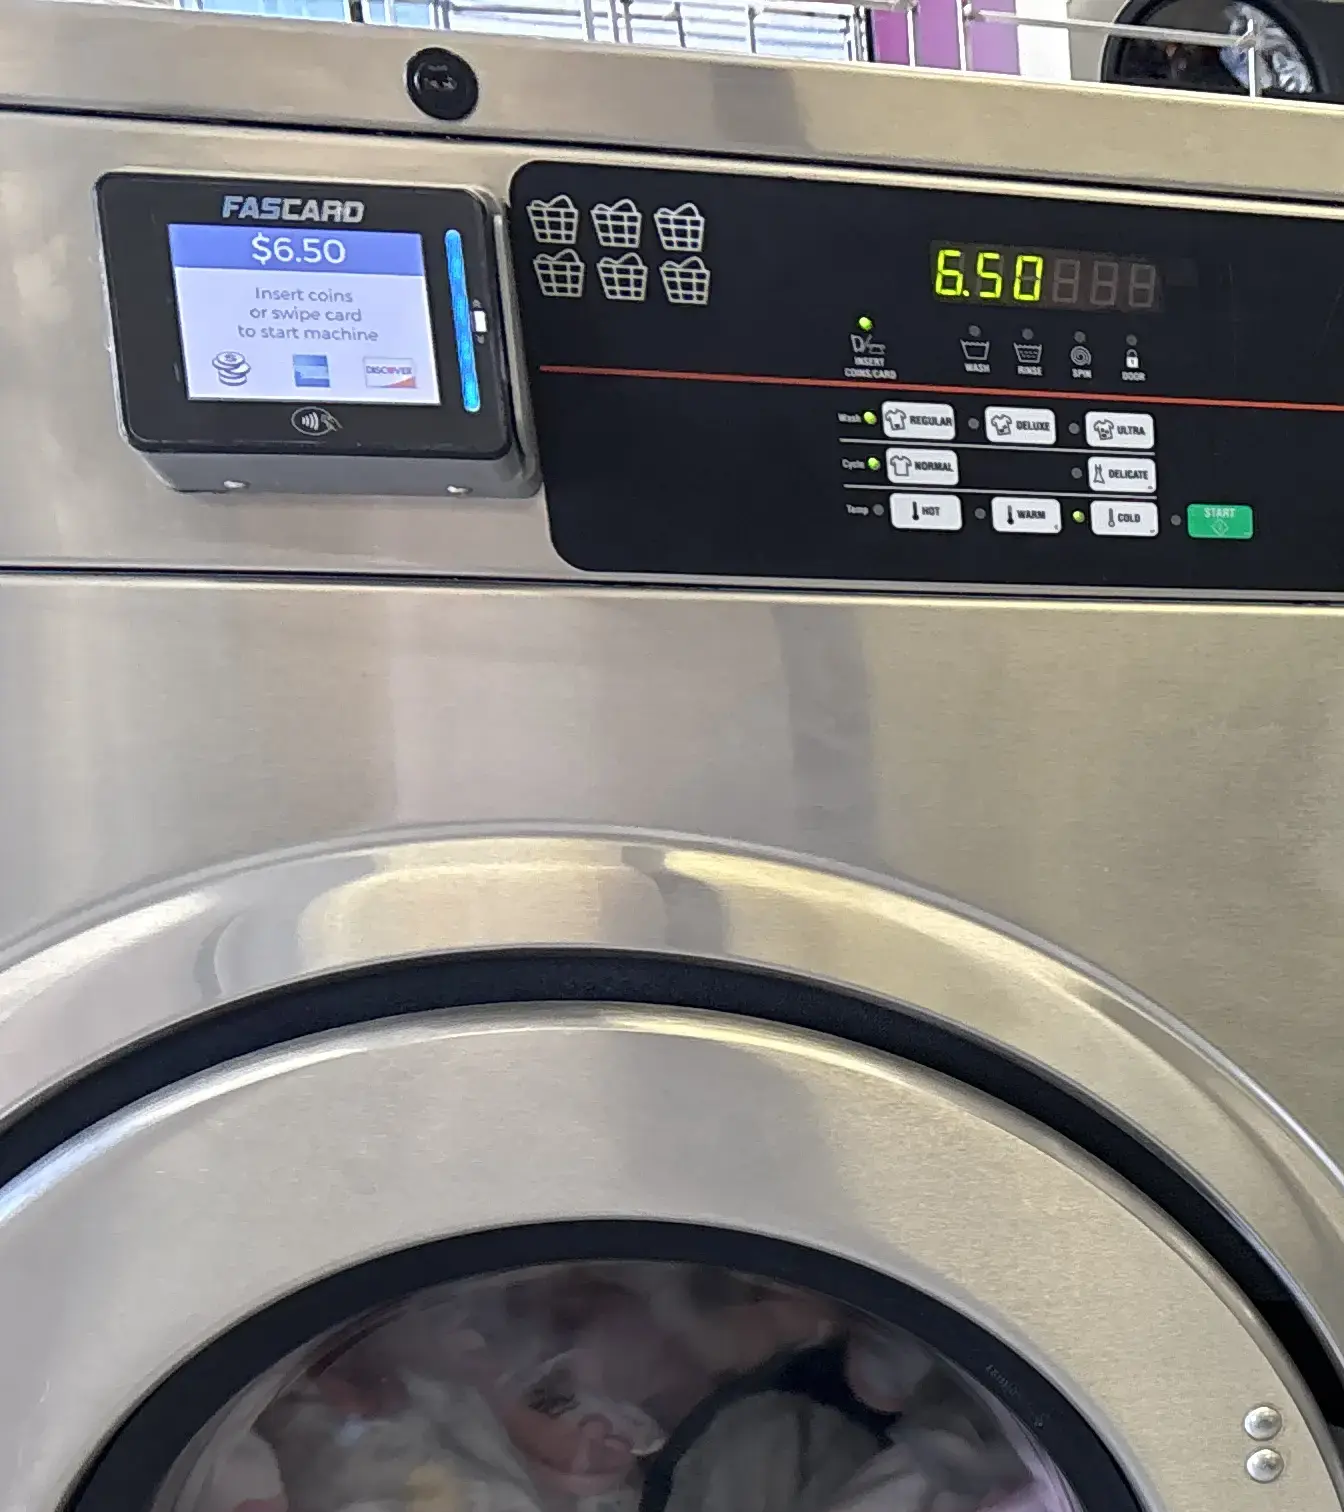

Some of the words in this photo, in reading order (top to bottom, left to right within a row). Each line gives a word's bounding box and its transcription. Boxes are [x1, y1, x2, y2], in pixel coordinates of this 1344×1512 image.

[220, 195, 365, 223] FASCARD
[251, 232, 346, 266] $6.50
[935, 249, 1043, 301] 6.50
[255, 286, 304, 302] Insert
[308, 288, 353, 303] coins
[249, 308, 267, 320] or
[271, 307, 320, 323] swipe
[324, 307, 362, 322] card
[237, 325, 257, 339] to
[260, 326, 300, 339] start
[303, 327, 379, 342] machine
[1072, 368, 1093, 380] SPIN
[909, 415, 953, 427] REGULAR
[1016, 420, 1050, 431] DELUXE
[1117, 425, 1146, 436] ULTRA
[914, 461, 954, 472] NORMAL
[1108, 469, 1149, 480] DELICATE
[921, 506, 940, 516] HOT
[1017, 509, 1046, 520] WARM
[1117, 513, 1141, 523] COLD
[1204, 507, 1236, 518] START
